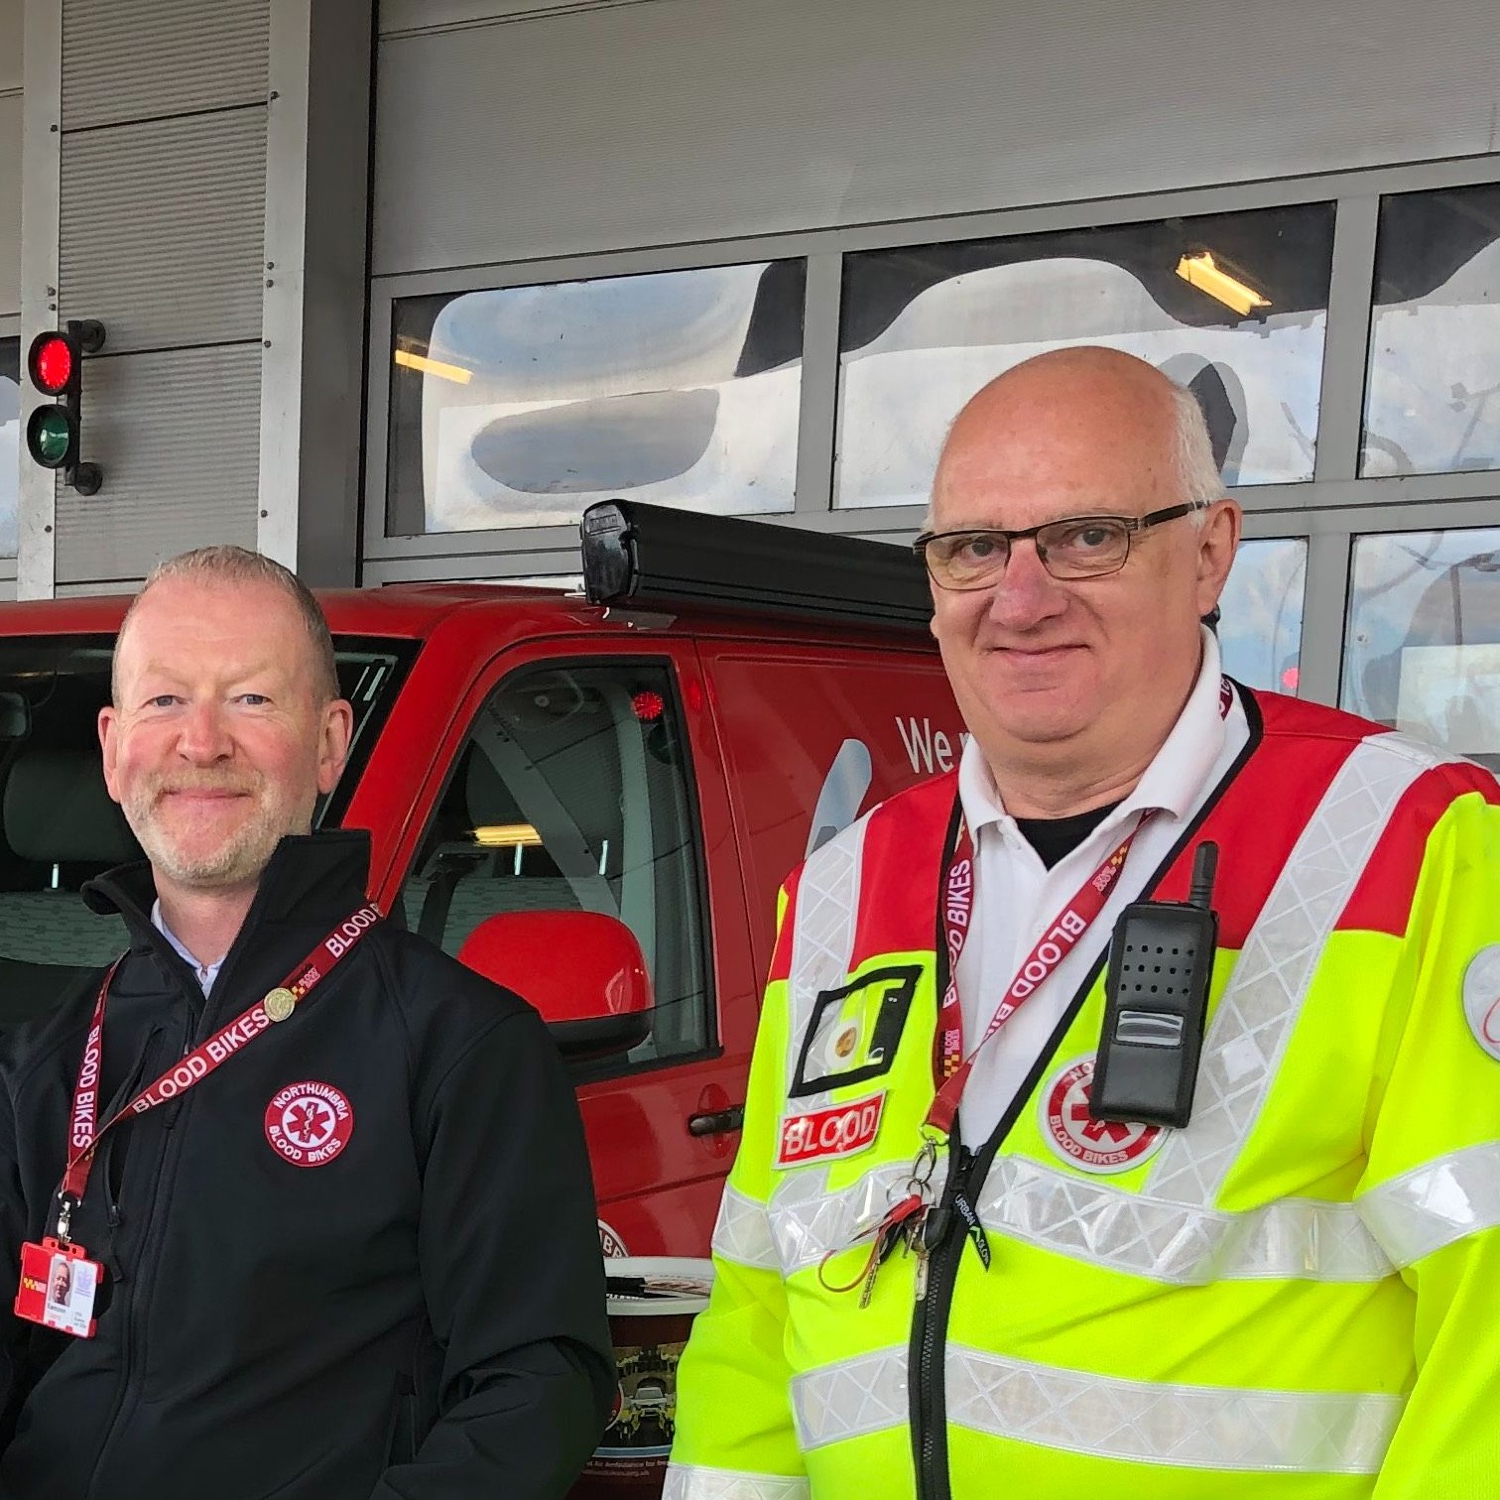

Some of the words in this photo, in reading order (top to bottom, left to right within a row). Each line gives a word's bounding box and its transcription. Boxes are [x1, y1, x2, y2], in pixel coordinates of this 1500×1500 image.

[895, 716, 954, 774] We
[947, 858, 971, 928] BIKES
[325, 908, 377, 958] BLOOD
[1011, 909, 1086, 998] BLOOD
[79, 1024, 100, 1088] BLOOD
[132, 1056, 207, 1113] BLOOD
[206, 1008, 270, 1062] BIKES
[73, 1091, 94, 1149] BIKES
[273, 1083, 349, 1120] NORTHUMBRIA
[269, 1125, 302, 1160] BLOOD
[308, 1138, 341, 1162] BIKES
[784, 1105, 876, 1156] BLOOD
[1049, 1115, 1082, 1156] BLOOD
[1082, 1150, 1129, 1164] BIKES
[954, 1193, 976, 1226] URBAN
